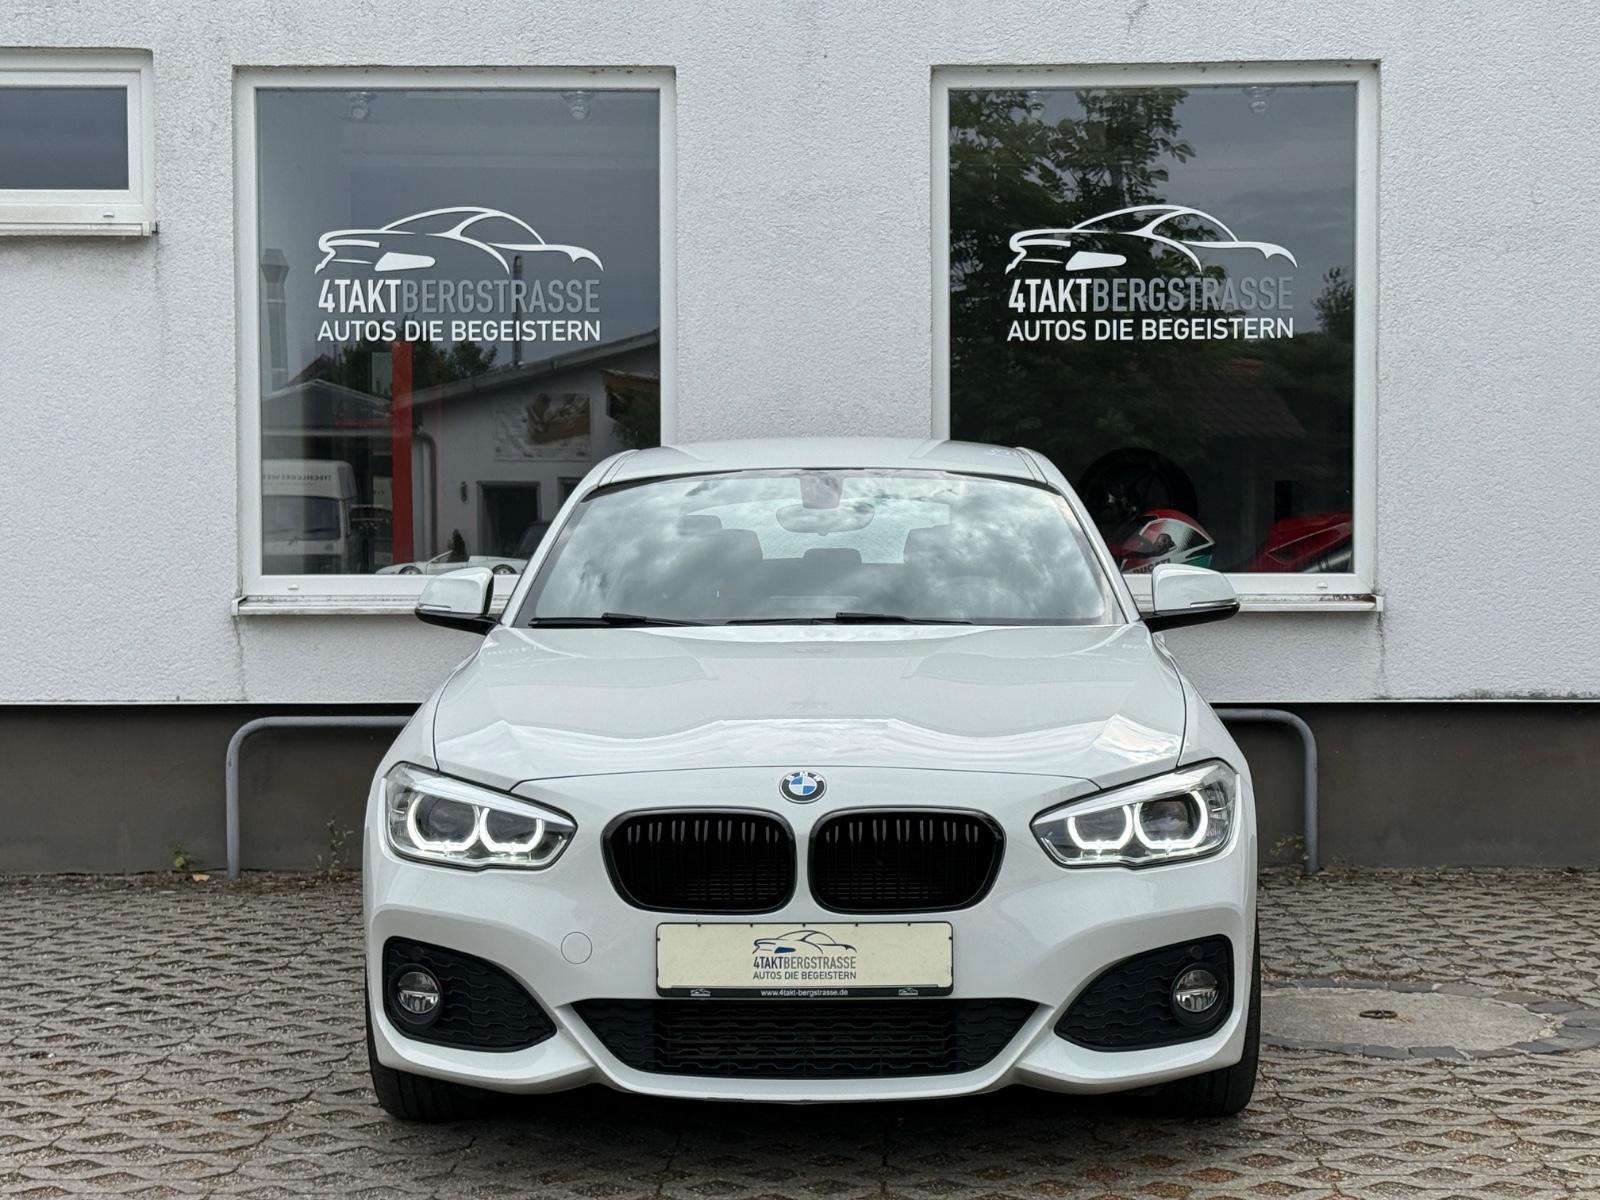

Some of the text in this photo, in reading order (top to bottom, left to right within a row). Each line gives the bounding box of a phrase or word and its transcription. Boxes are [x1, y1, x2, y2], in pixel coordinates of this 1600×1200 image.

[317, 320, 600, 342] AUTOS DIE BEGEISTERN
[1007, 317, 1294, 342] AUTOS DIE BEGEISTERN
[753, 971, 856, 980] AUTOS DIE BEGEISTERN
[760, 988, 848, 998] www.4takt-bergstrasse.de
